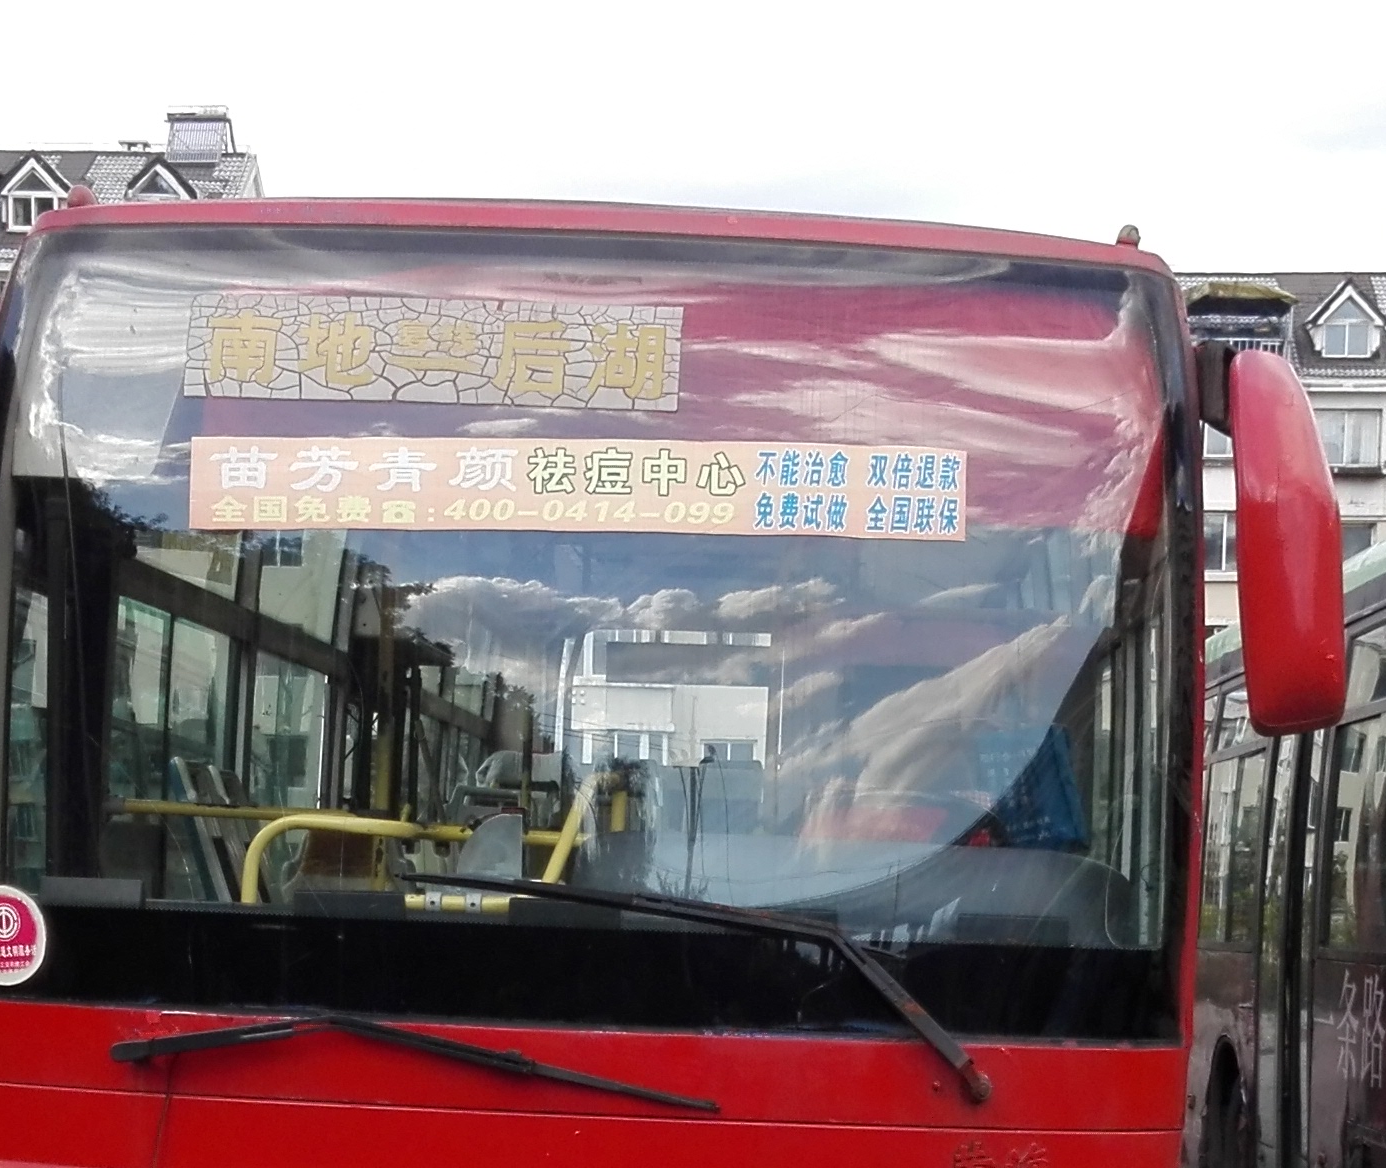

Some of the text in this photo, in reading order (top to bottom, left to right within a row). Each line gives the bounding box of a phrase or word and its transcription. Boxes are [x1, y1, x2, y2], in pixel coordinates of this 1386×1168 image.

[754, 450, 849, 486] 不能治愈
[866, 453, 960, 490] 双倍退款
[865, 496, 960, 534] 全国联保
